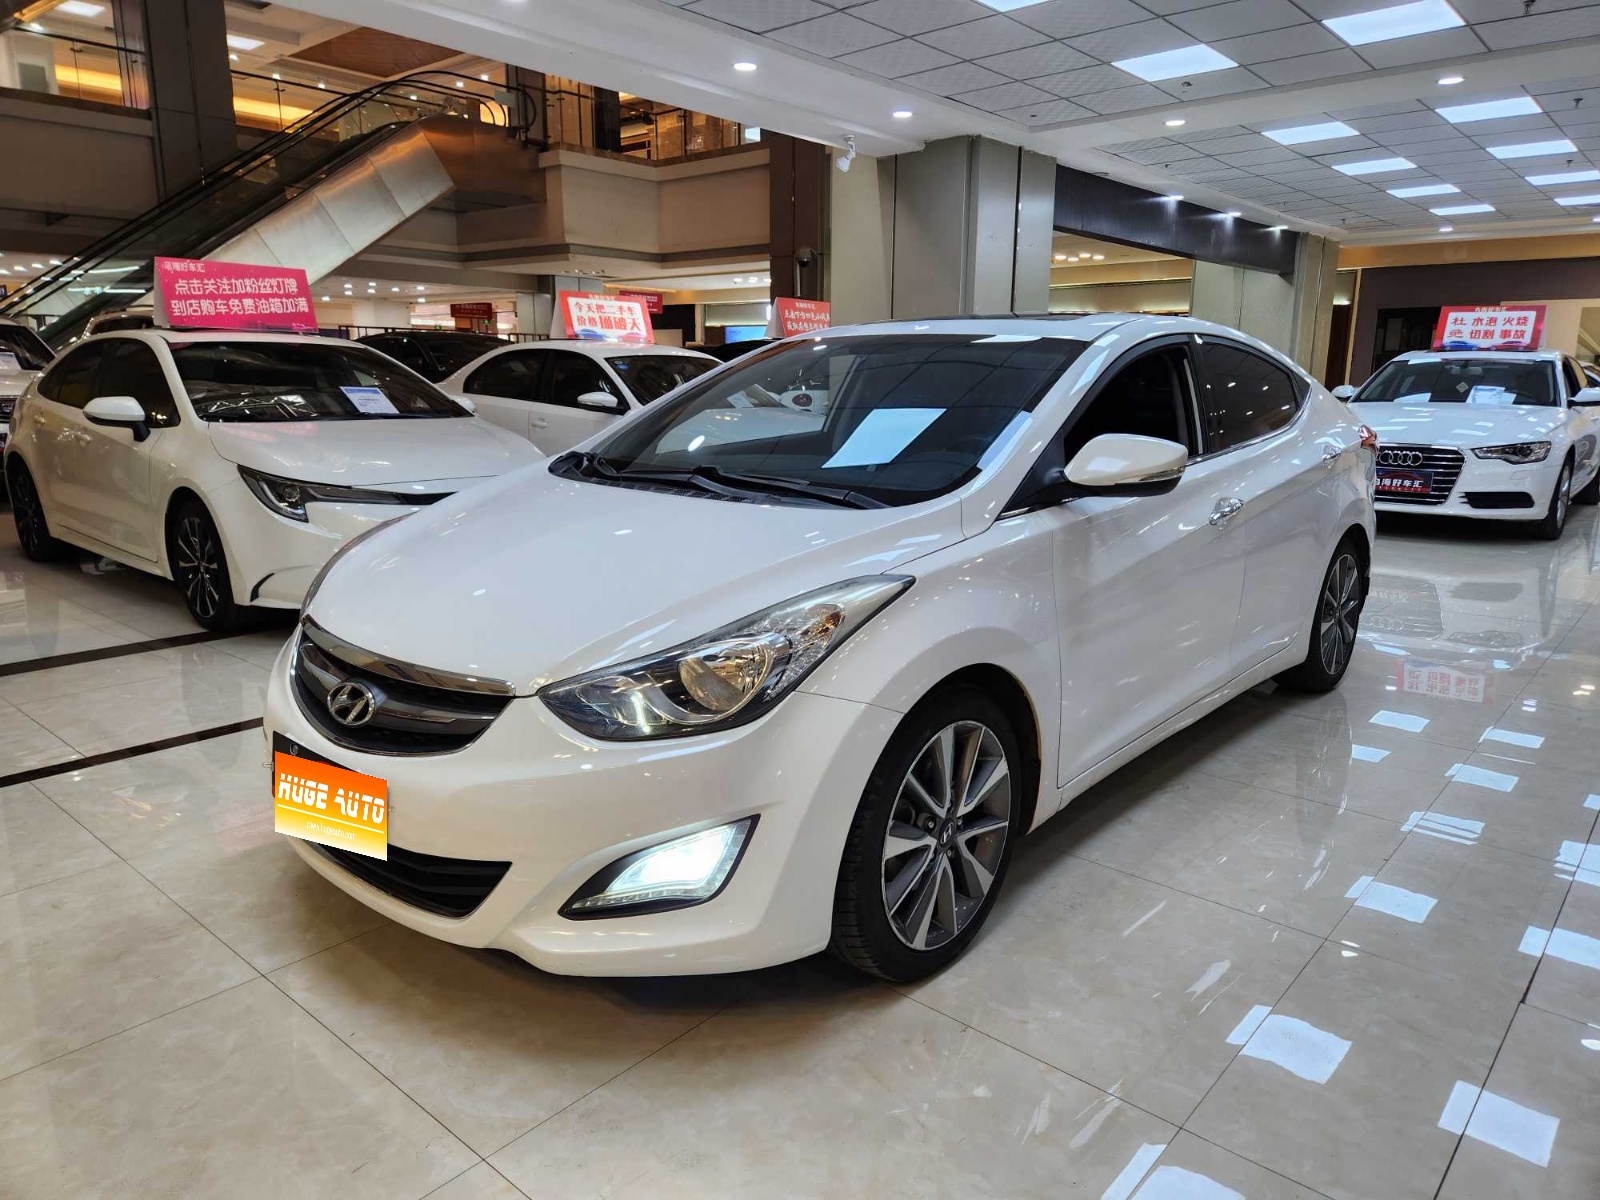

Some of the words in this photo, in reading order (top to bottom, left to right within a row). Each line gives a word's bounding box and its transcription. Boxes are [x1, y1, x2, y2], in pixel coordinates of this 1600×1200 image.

[174, 276, 299, 296] 点击关注加粉丝灯牌
[170, 297, 310, 317] 到店购车免费油箱加满
[574, 301, 636, 317] 今天把二手车
[1451, 316, 1467, 326] 杜
[1471, 316, 1498, 327] 水泡
[1502, 316, 1529, 326] 火烧
[1469, 329, 1496, 339] 切割
[1499, 329, 1526, 339] 事故
